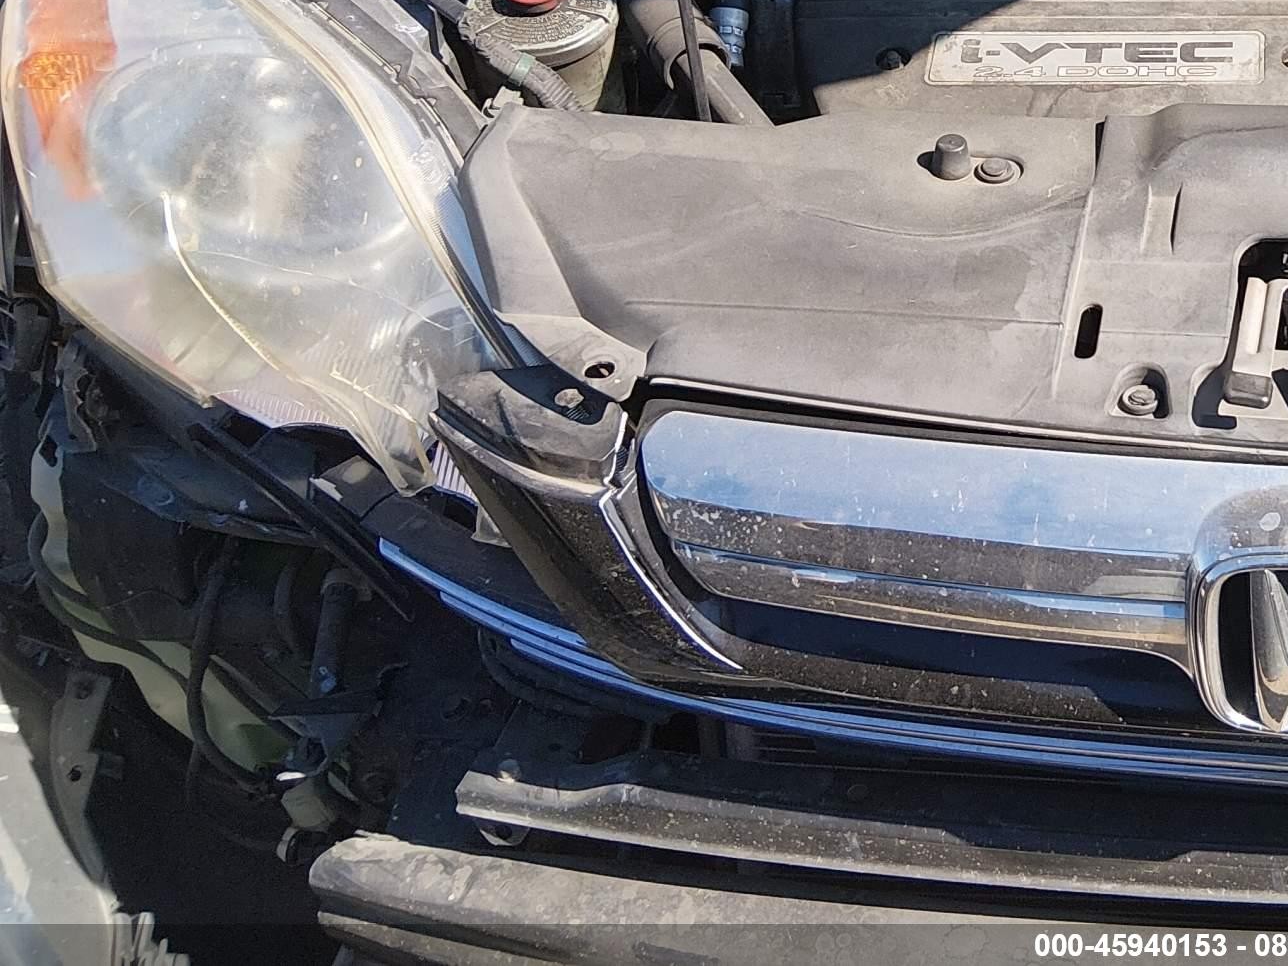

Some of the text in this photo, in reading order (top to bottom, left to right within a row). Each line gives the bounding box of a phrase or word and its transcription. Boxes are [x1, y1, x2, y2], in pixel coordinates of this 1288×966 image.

[960, 39, 1233, 65] i-VTEC
[973, 65, 1217, 79] 2.4 DOHC
